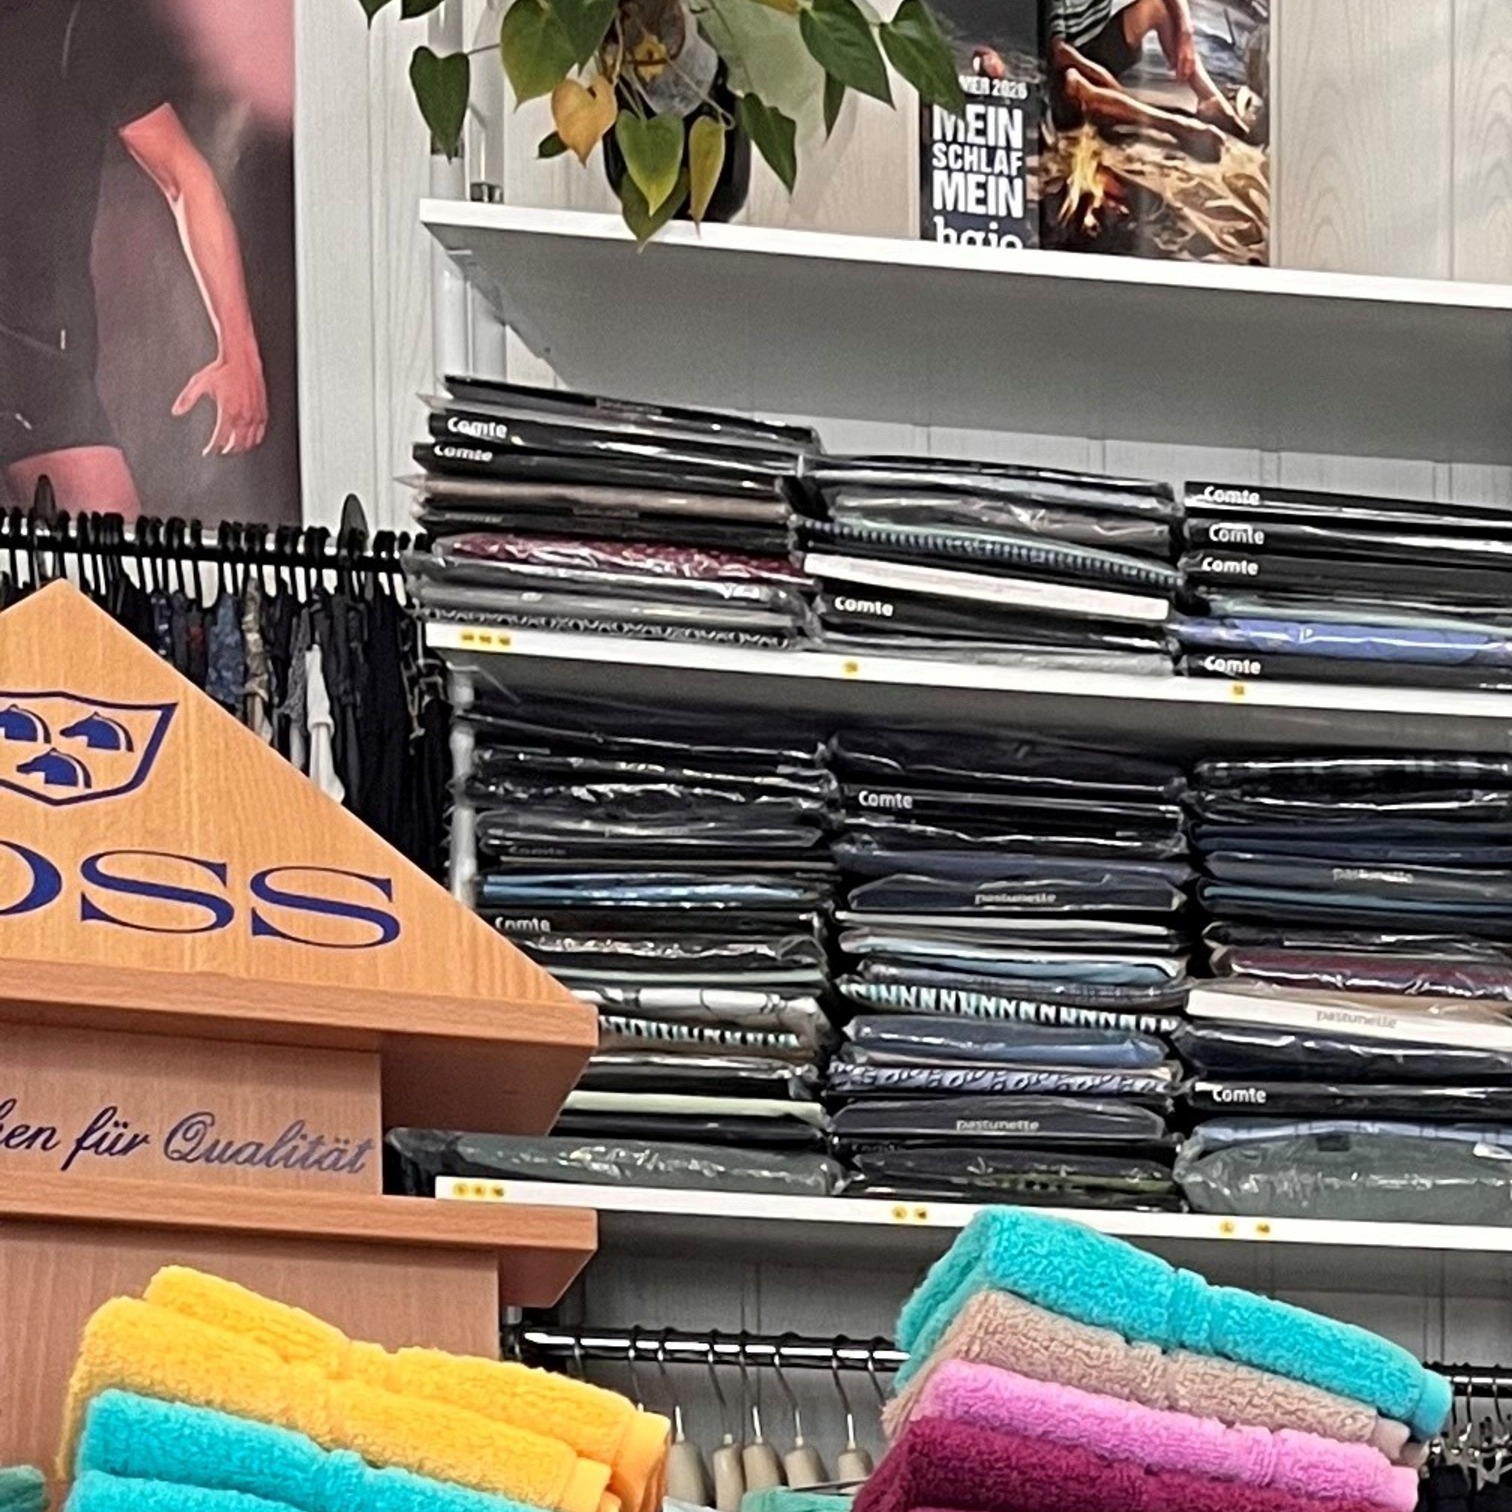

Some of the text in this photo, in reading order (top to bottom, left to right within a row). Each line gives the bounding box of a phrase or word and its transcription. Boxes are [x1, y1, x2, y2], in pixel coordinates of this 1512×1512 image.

[932, 103, 1023, 149] MEIN
[932, 142, 1023, 176] SCHLAF
[932, 169, 1024, 218] MEIN
[447, 416, 507, 439] Comte
[1203, 485, 1261, 506] Comte
[1208, 525, 1265, 546] Comte
[1202, 556, 1259, 576] Comte
[834, 596, 894, 617] Comte
[1204, 655, 1261, 675] Comte
[858, 790, 913, 809] Comte
[0, 840, 402, 950] SS
[1212, 1087, 1267, 1104] Comte
[60, 1105, 151, 1172] für
[163, 1111, 376, 1175] Qualität
